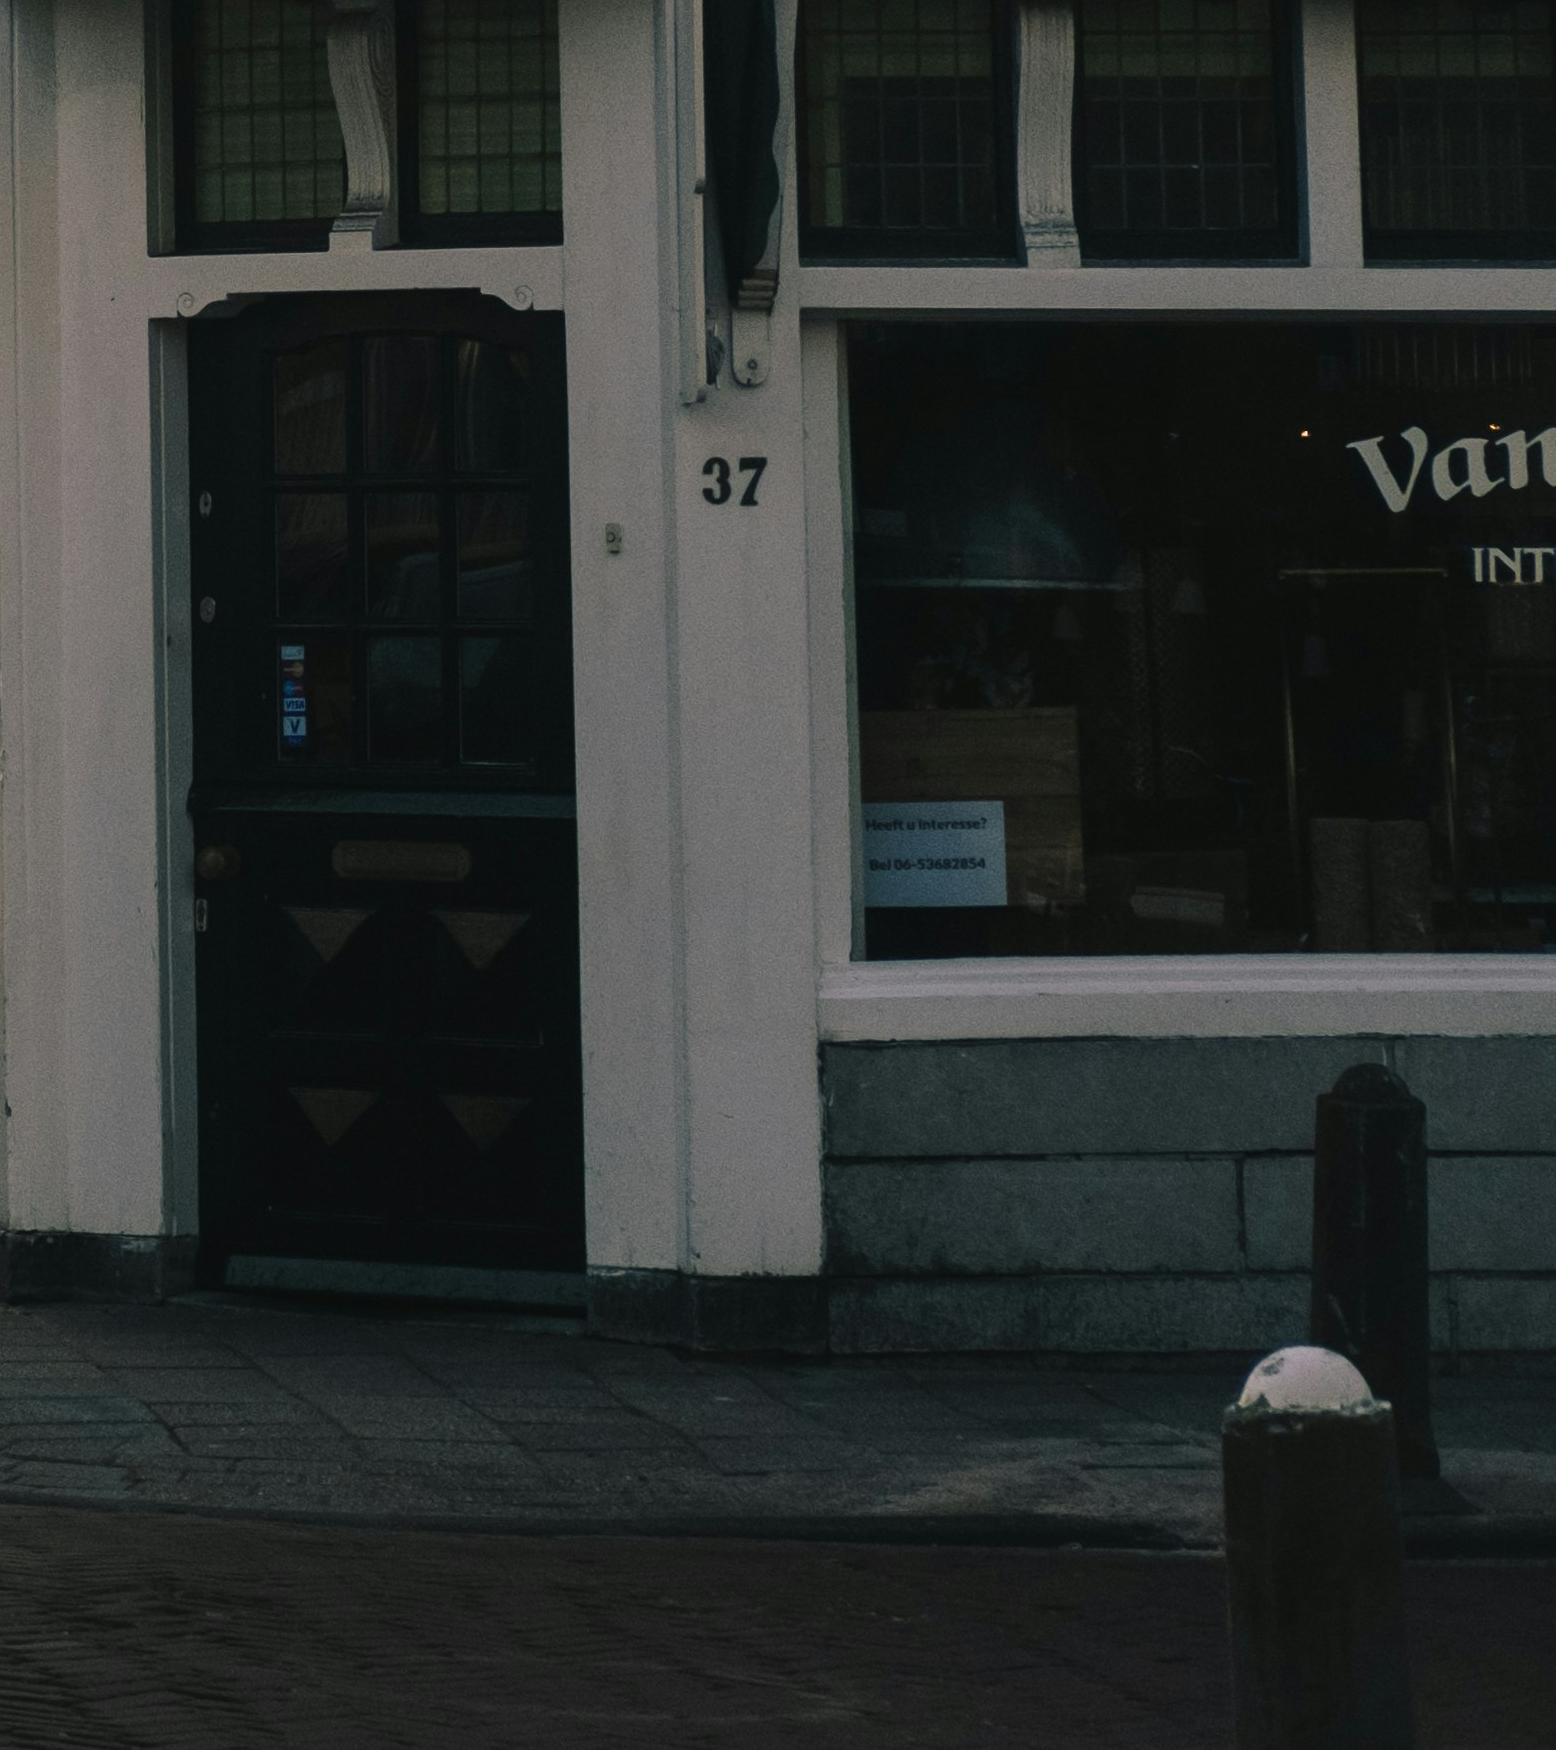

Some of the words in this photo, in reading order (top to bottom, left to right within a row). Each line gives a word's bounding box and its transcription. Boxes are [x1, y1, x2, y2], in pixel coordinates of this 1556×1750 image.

[702, 456, 768, 507] 37
[1472, 547, 1555, 584] INT
[285, 701, 304, 710] VISA
[866, 818, 903, 832] Heeft
[907, 821, 915, 830] u
[869, 858, 891, 871] Bel
